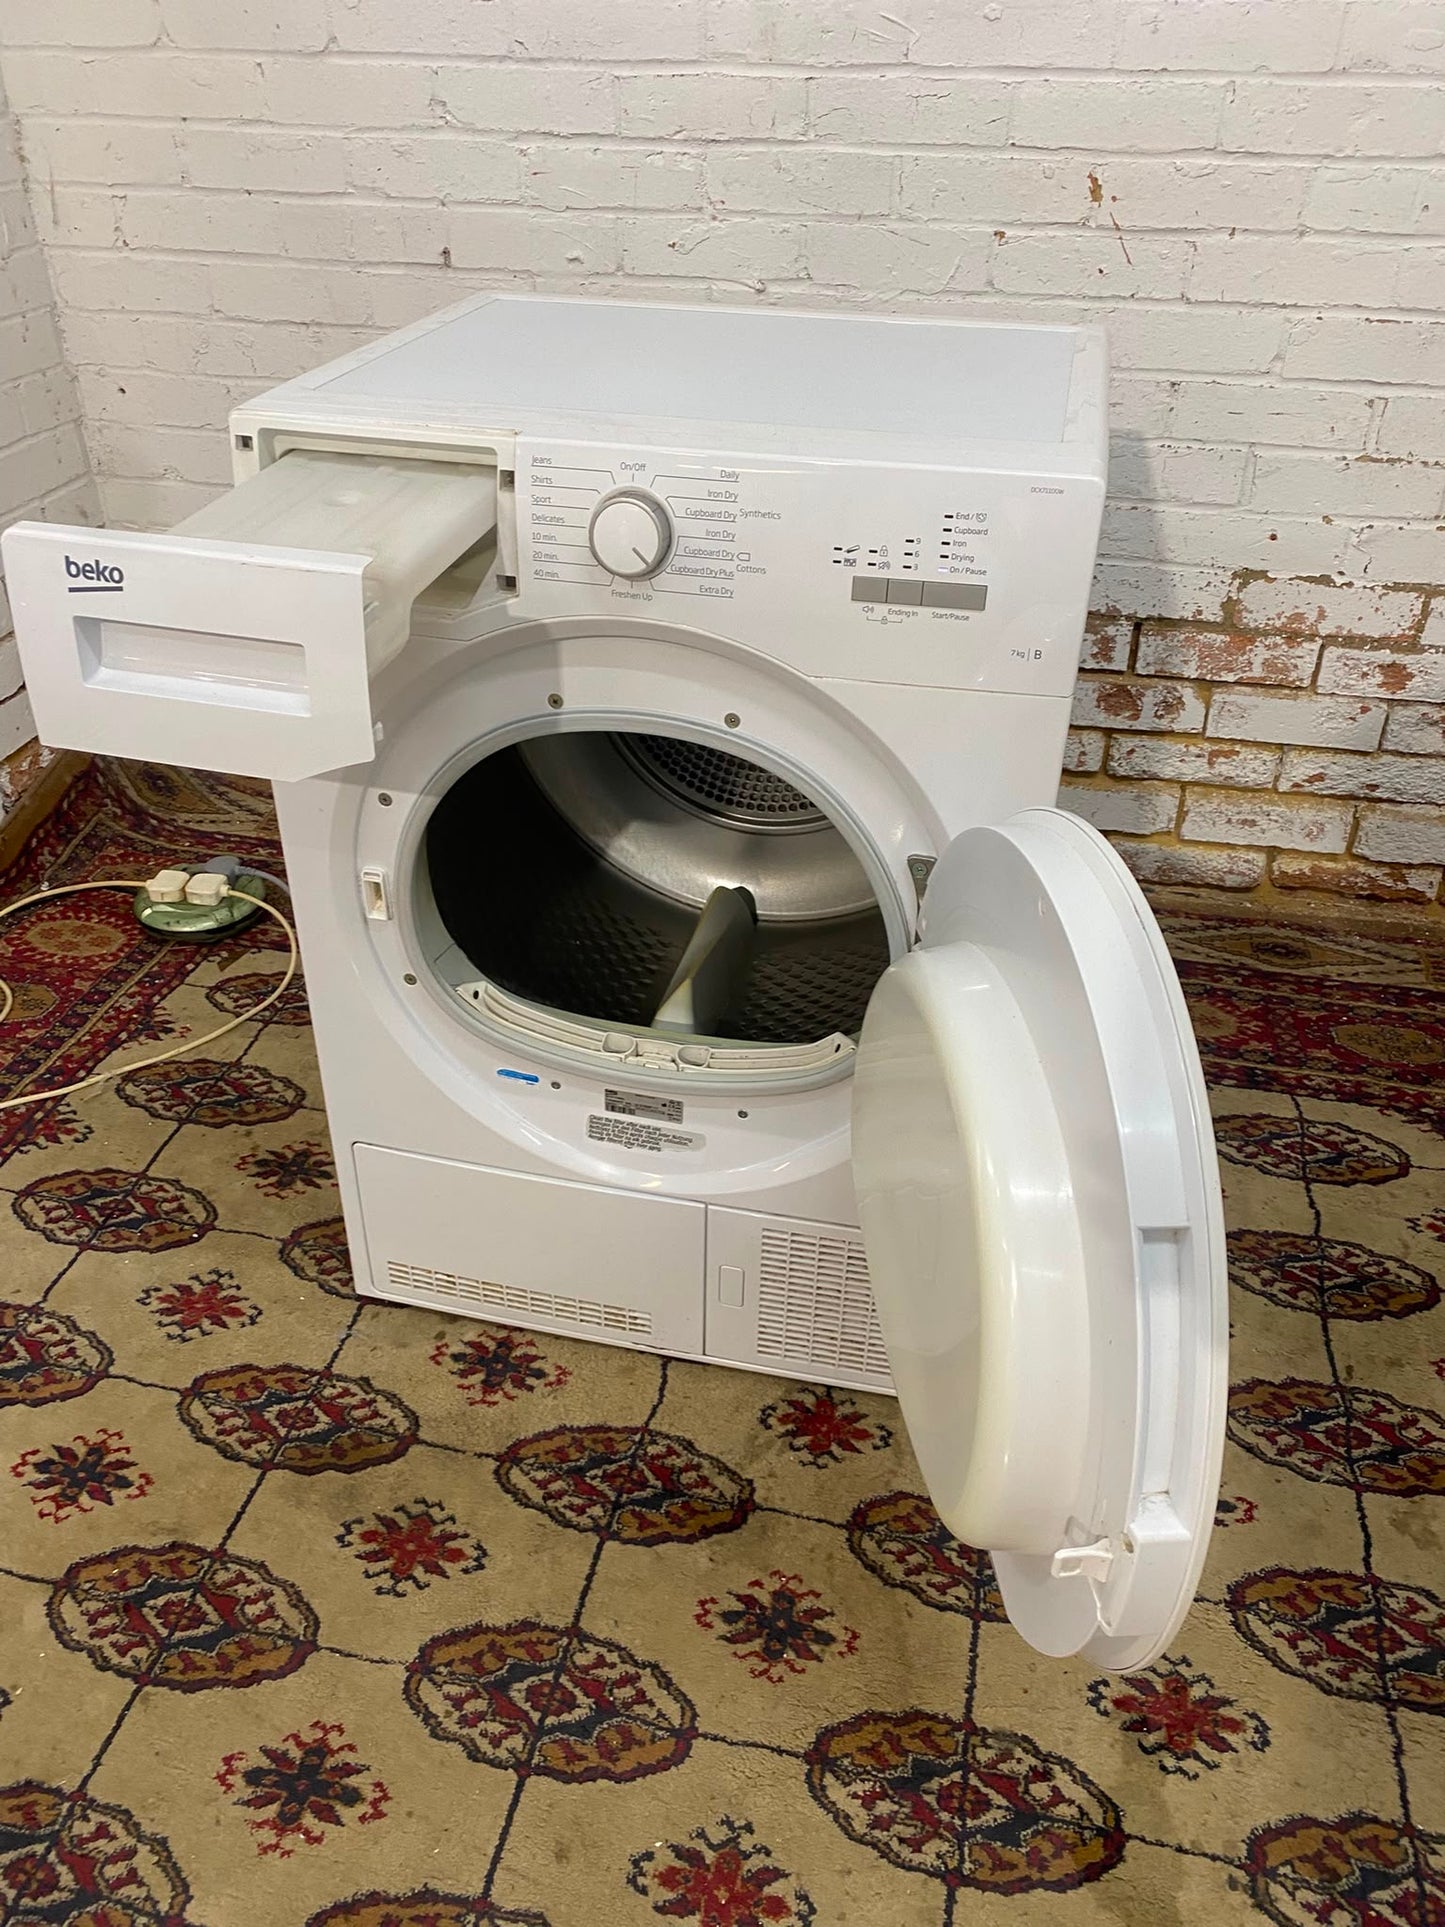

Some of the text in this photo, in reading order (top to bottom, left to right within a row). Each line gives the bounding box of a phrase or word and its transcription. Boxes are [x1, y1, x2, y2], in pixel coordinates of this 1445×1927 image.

[532, 456, 552, 465] Jeans
[620, 462, 647, 472] On/Off
[531, 475, 553, 484] Shirts
[720, 470, 740, 480] Daily
[531, 495, 552, 504] Sport
[708, 489, 739, 501] Iron Dry
[531, 513, 565, 524] Delicates
[685, 507, 738, 521] Cupboard Dry
[740, 508, 782, 520] Synthetics
[956, 512, 970, 520] End
[532, 532, 557, 541] 10 min.
[705, 529, 736, 540] Iron Dry
[954, 527, 988, 536] Cupboard
[533, 551, 559, 560] 20 min.
[684, 546, 736, 560] Cupboard Dry
[951, 553, 975, 563] Drying
[64, 555, 124, 584] beko
[534, 569, 560, 578] 40 min.
[670, 564, 735, 578] Cupboard Dry Plus
[736, 564, 767, 575] Cottons
[949, 566, 960, 574] On
[965, 568, 987, 576] Pause
[611, 589, 653, 601] Freshen Up
[700, 585, 734, 596] Extra Dry
[887, 608, 911, 618] Ending
[932, 611, 970, 621] Start/Pause
[1034, 649, 1042, 660] B
